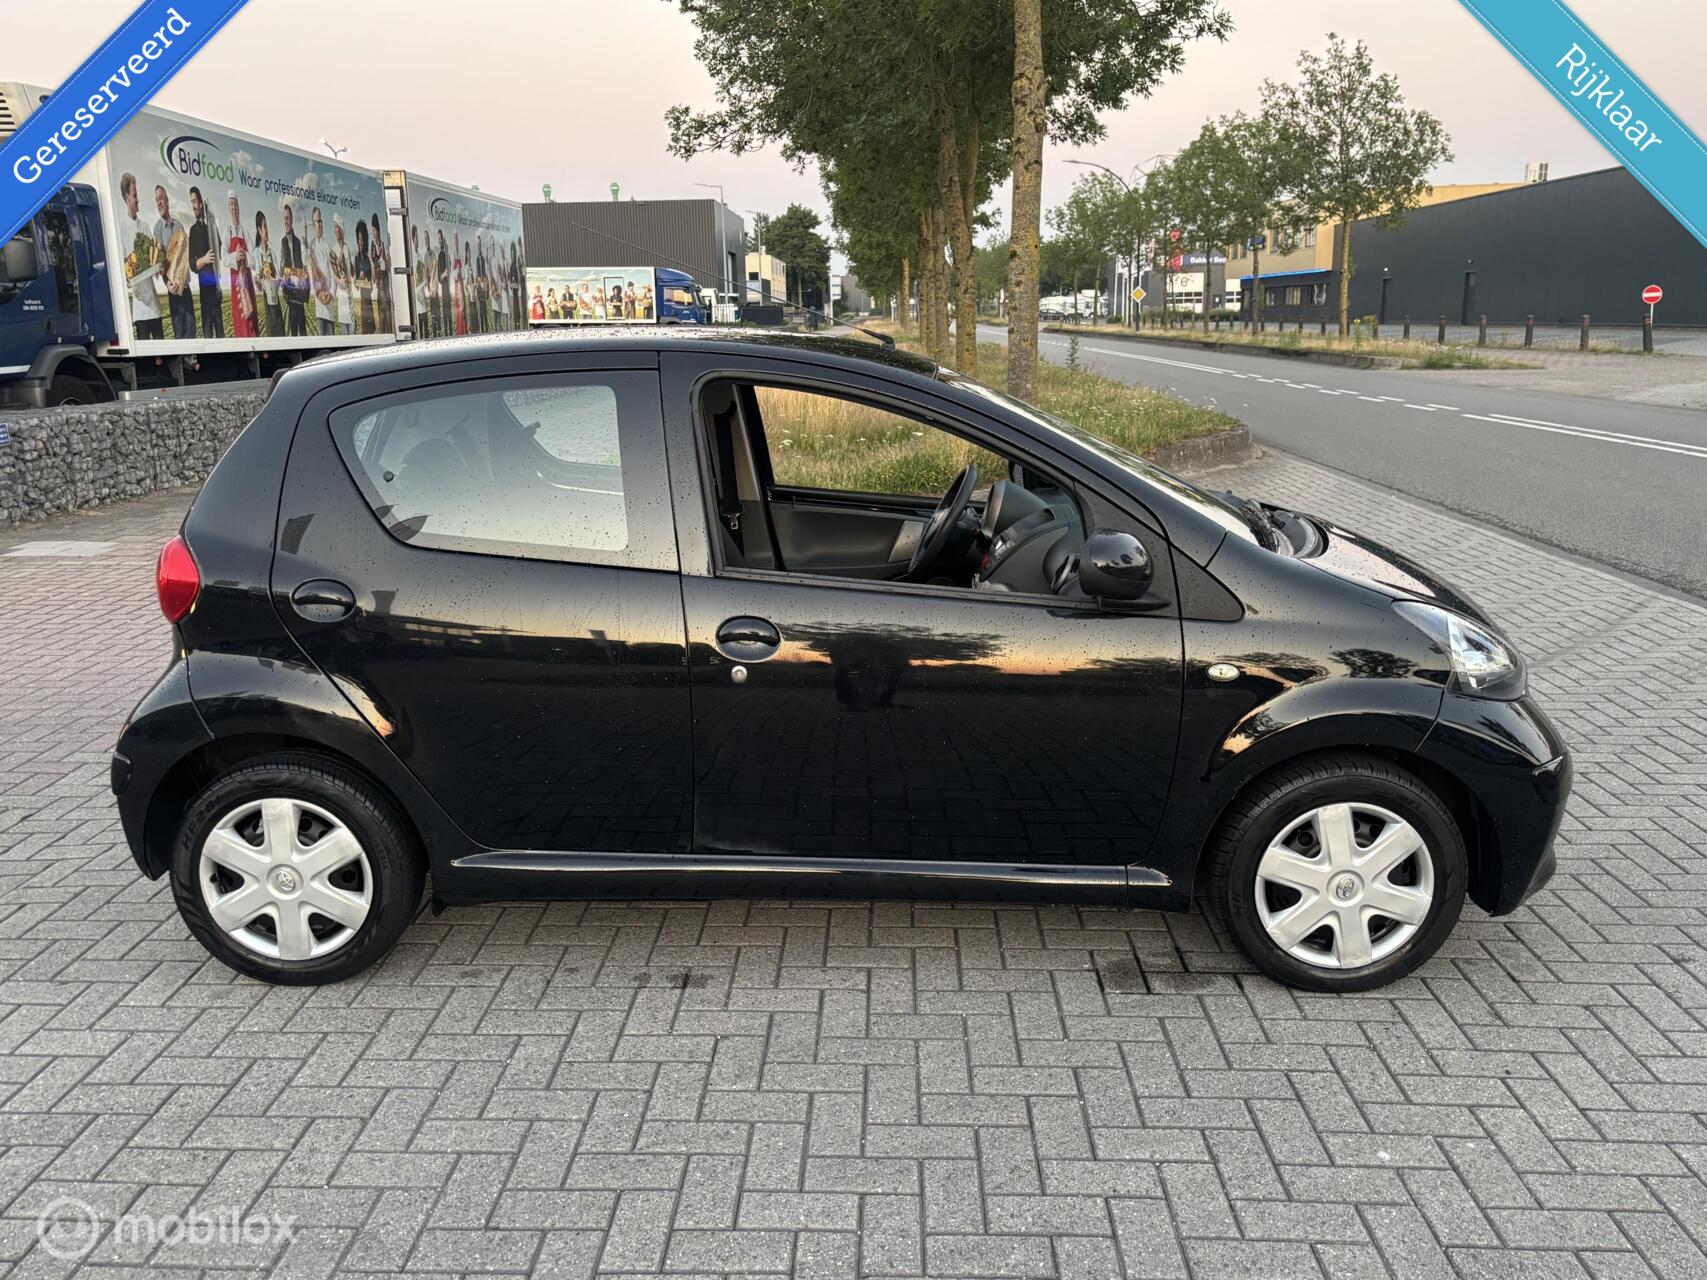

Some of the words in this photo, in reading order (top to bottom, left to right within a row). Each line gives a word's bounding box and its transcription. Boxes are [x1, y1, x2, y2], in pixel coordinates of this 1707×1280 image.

[178, 147, 235, 184] Bidfood
[238, 169, 262, 188] Waar
[264, 178, 315, 201] professionals
[316, 191, 338, 206] elkaar
[339, 195, 361, 211] vinden
